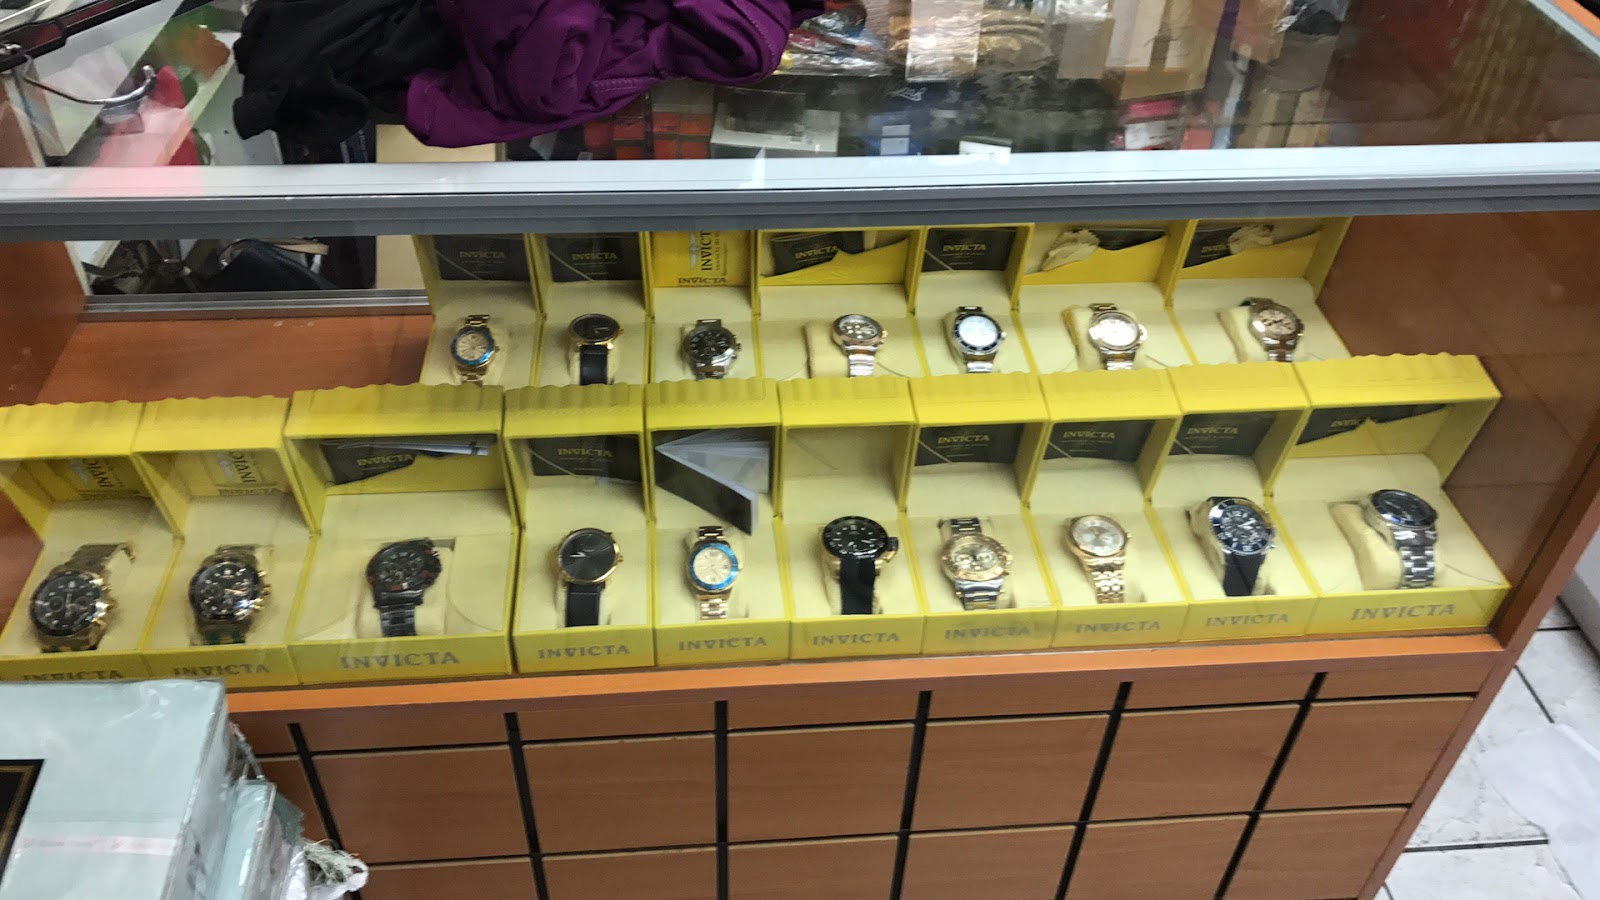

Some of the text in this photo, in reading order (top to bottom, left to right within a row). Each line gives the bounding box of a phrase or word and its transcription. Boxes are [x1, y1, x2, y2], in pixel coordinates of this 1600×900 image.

[459, 251, 506, 259] INVICTA
[572, 252, 618, 261] INVICTA
[700, 230, 712, 271] INVICT
[1063, 430, 1116, 440] INVICTA
[1187, 426, 1238, 436] INVICTA
[937, 434, 990, 444] INVICTA
[356, 453, 414, 466] INVICTA
[558, 448, 613, 457] INVICTA
[1351, 603, 1455, 622] INVICTA
[1075, 620, 1161, 634] INVICTA
[1205, 613, 1289, 628] INVICTA
[812, 631, 901, 646] INVICTA
[944, 625, 1031, 640] INVICTA
[678, 636, 768, 651] INVICTA
[537, 643, 631, 660] INVICTA
[341, 651, 460, 670] INVICTA
[172, 663, 271, 677] INVICTA
